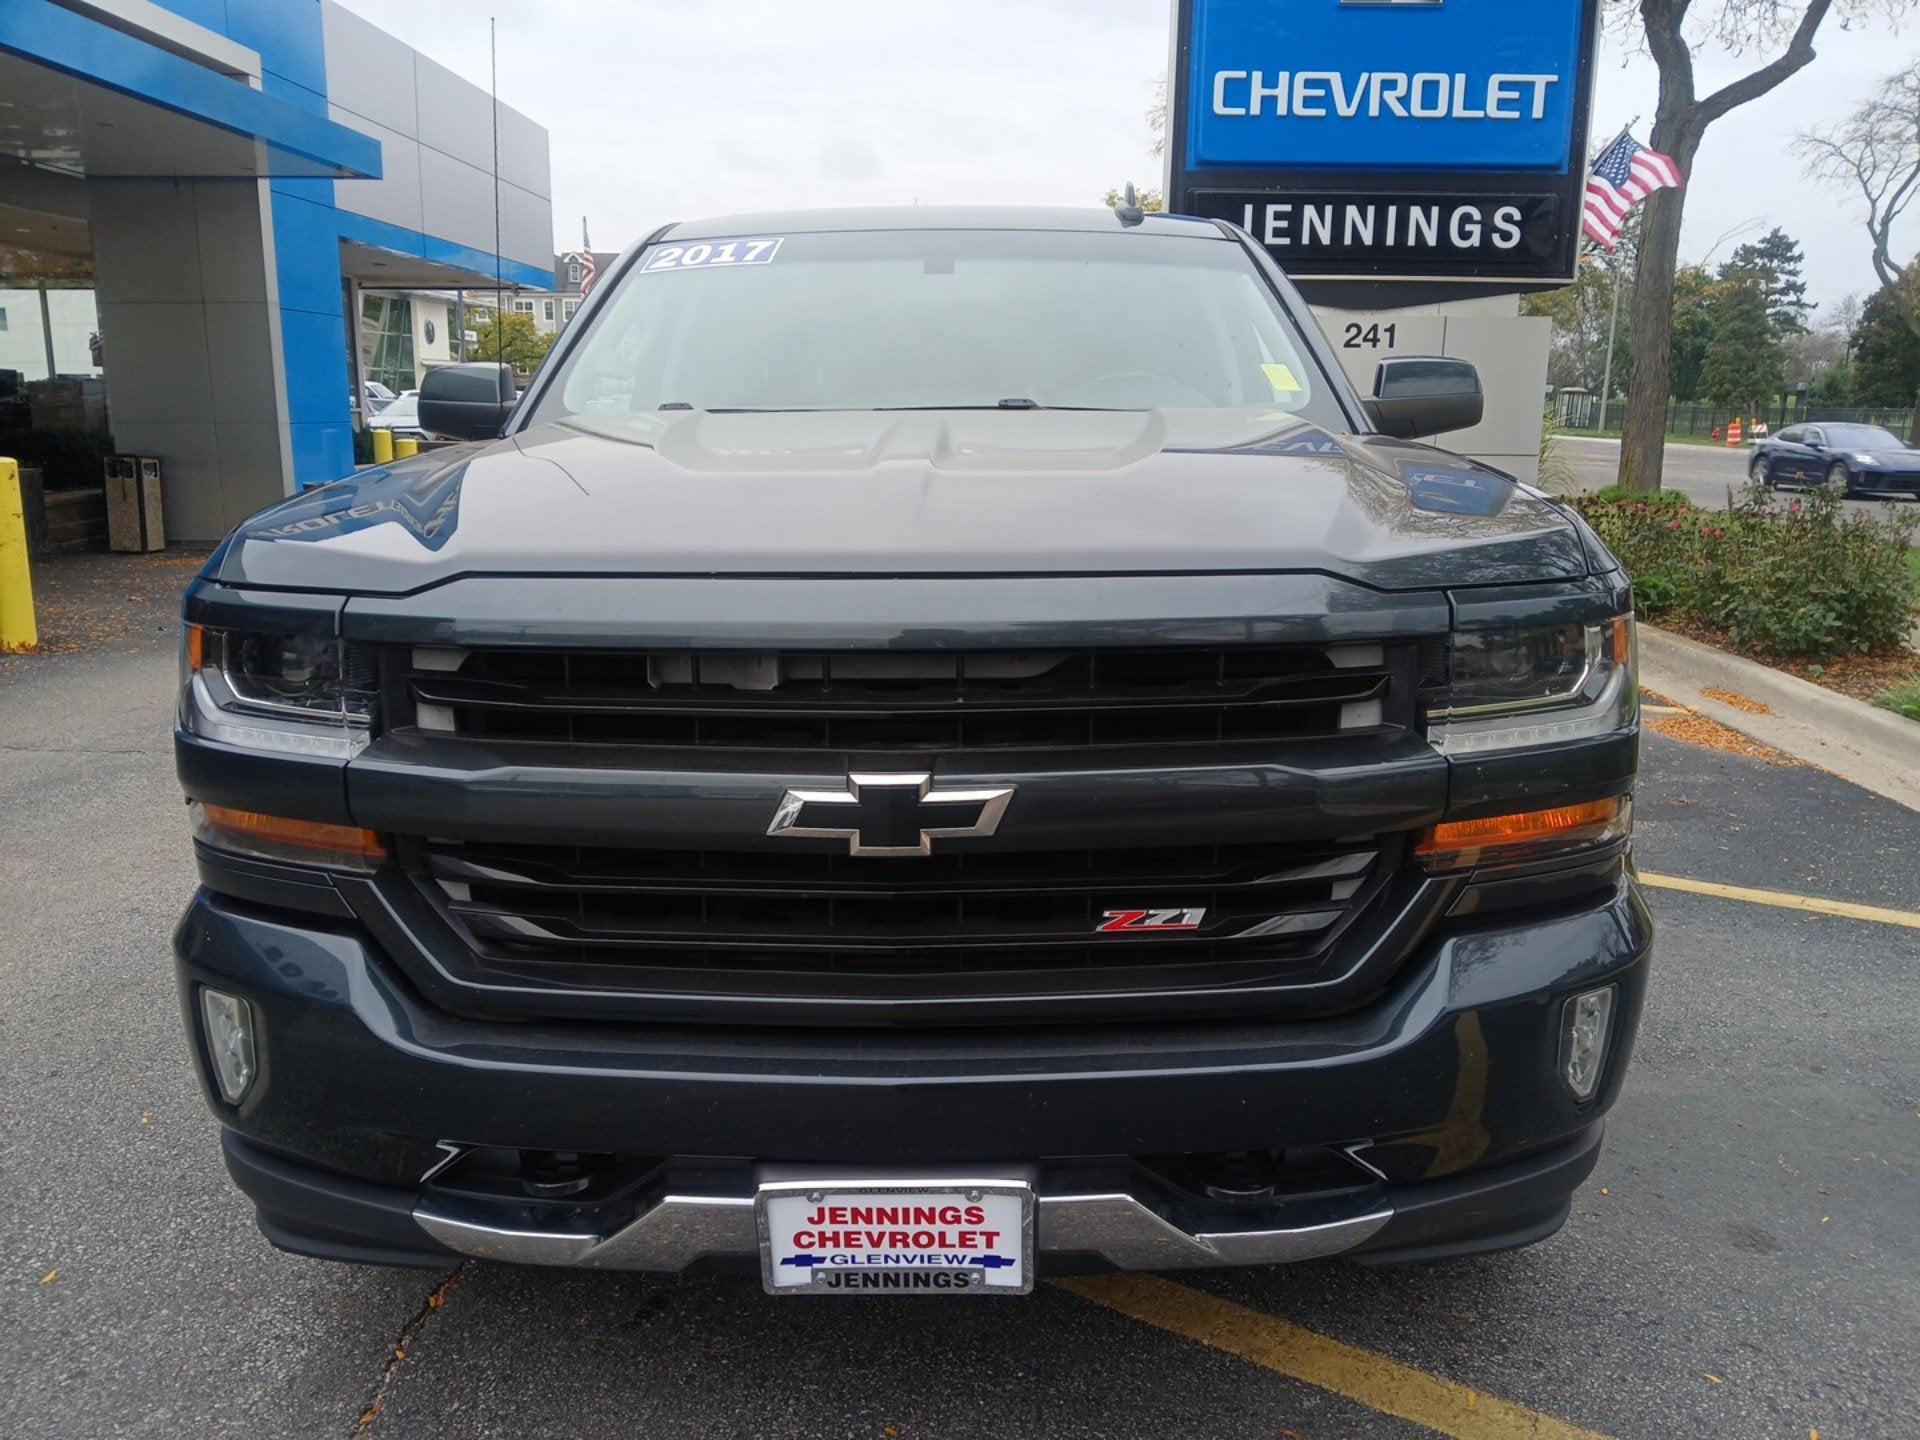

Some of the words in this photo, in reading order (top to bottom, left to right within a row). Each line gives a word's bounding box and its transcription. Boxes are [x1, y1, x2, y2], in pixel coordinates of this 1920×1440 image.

[1212, 70, 1559, 120] CHEVROLET
[649, 240, 775, 269] 2017
[1343, 322, 1396, 348] 241
[1095, 907, 1207, 932] Z71
[807, 1206, 985, 1226] JENNINGS
[793, 1230, 1001, 1250] CHEVROLET
[830, 1254, 968, 1266] GLENVIEW
[827, 1271, 970, 1289] JENNINGS
